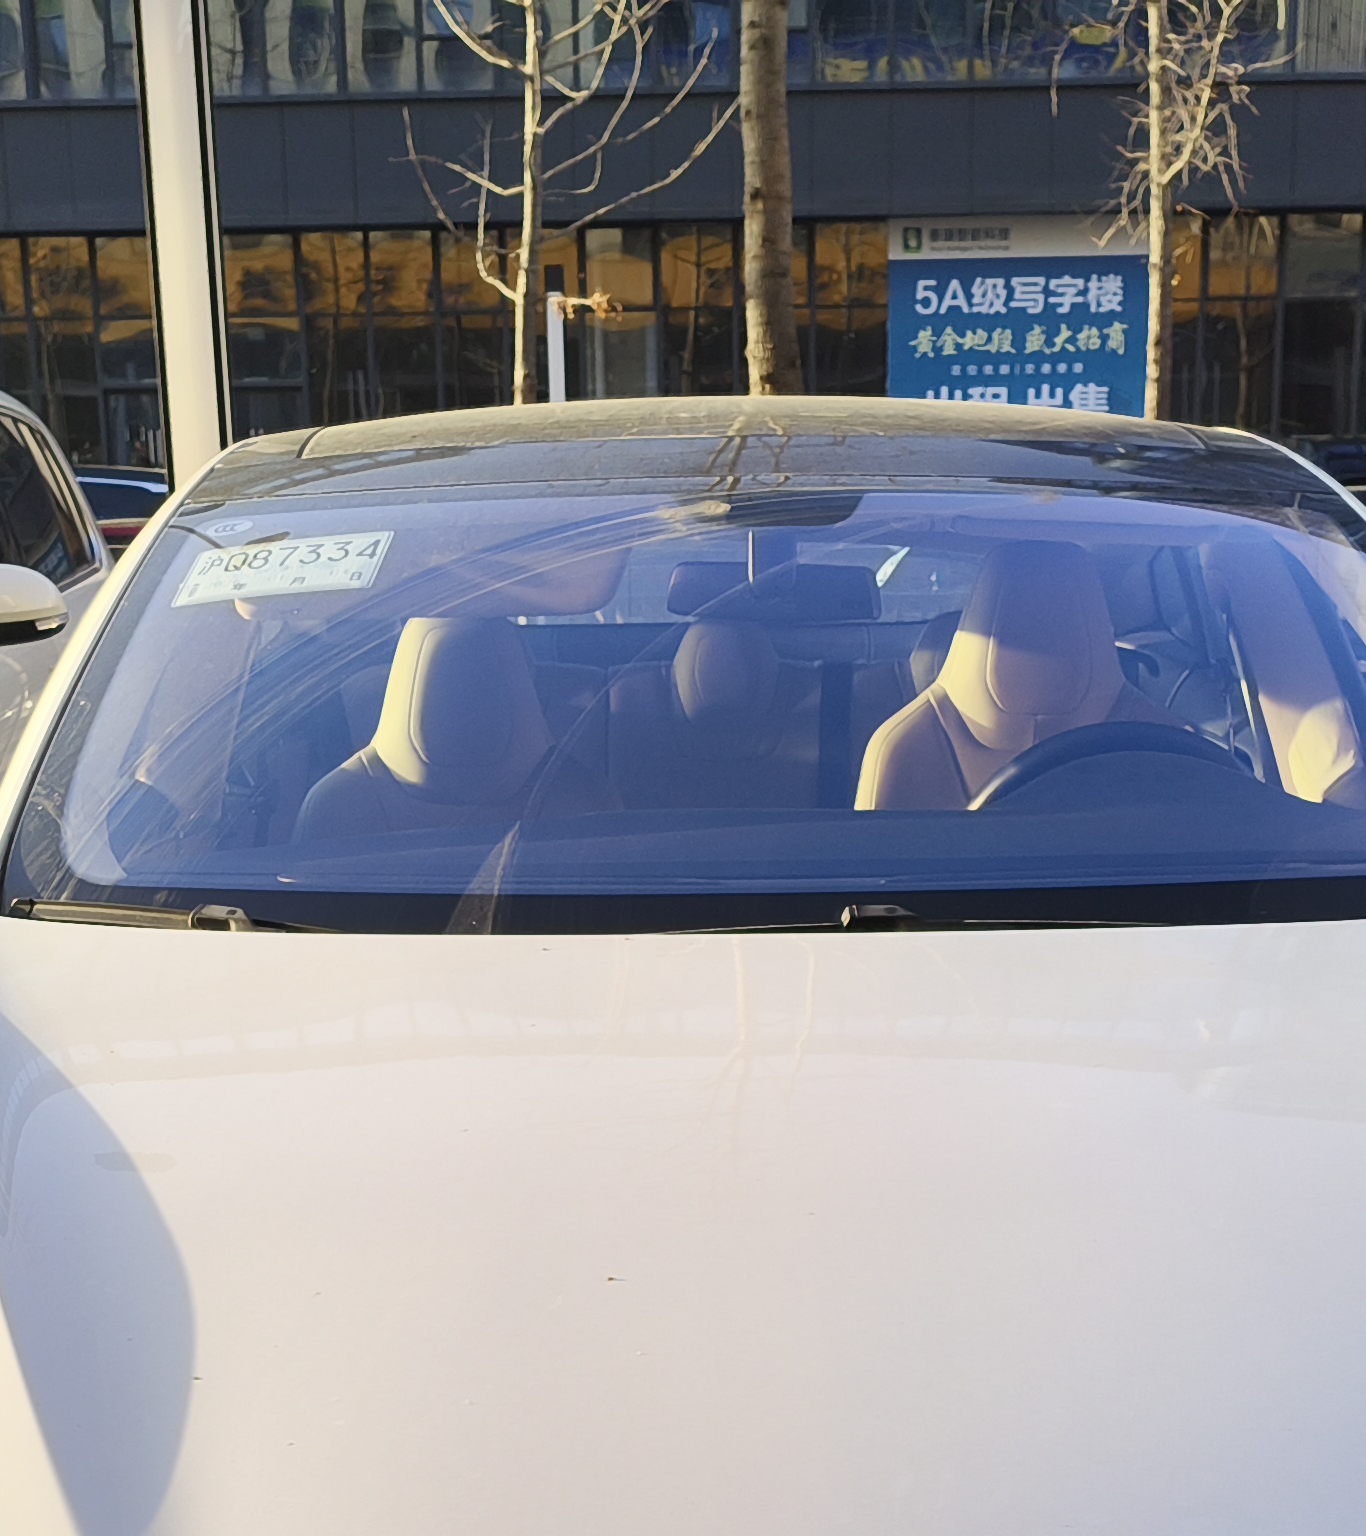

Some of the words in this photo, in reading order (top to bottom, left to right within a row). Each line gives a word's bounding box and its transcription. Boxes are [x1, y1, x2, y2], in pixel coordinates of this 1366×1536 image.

[914, 274, 1124, 315] 5A级写字楼
[198, 538, 382, 576] 沪Q87334
